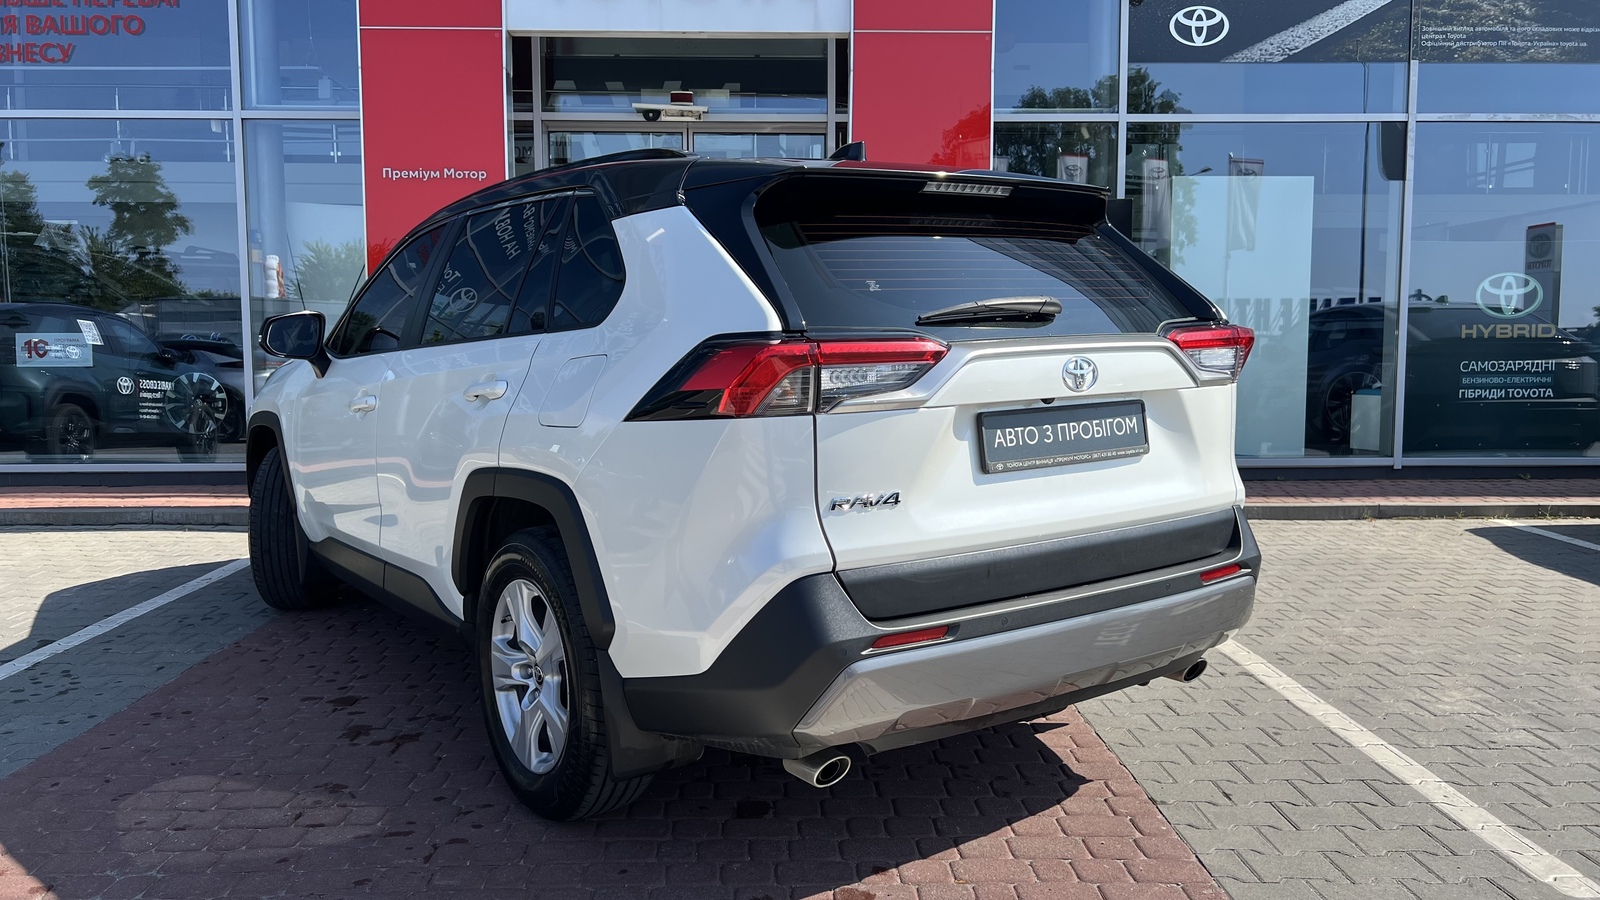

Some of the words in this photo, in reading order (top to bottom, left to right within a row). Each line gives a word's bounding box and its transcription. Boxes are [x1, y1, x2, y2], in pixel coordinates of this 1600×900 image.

[3, 14, 17, 34] Я
[25, 14, 144, 35] ВАШОГО
[382, 167, 440, 181] Преміум
[443, 167, 487, 182] Мотор
[1461, 323, 1557, 339] HYBRID
[1460, 360, 1556, 373] САМОЗАРЯДНІ
[1459, 388, 1505, 399] ГІБРИДИ
[1507, 388, 1554, 398] TOYOTA
[994, 426, 1039, 448] АВТО
[1057, 416, 1139, 442] ПРОБІГОМ
[828, 490, 902, 512] RAV4
